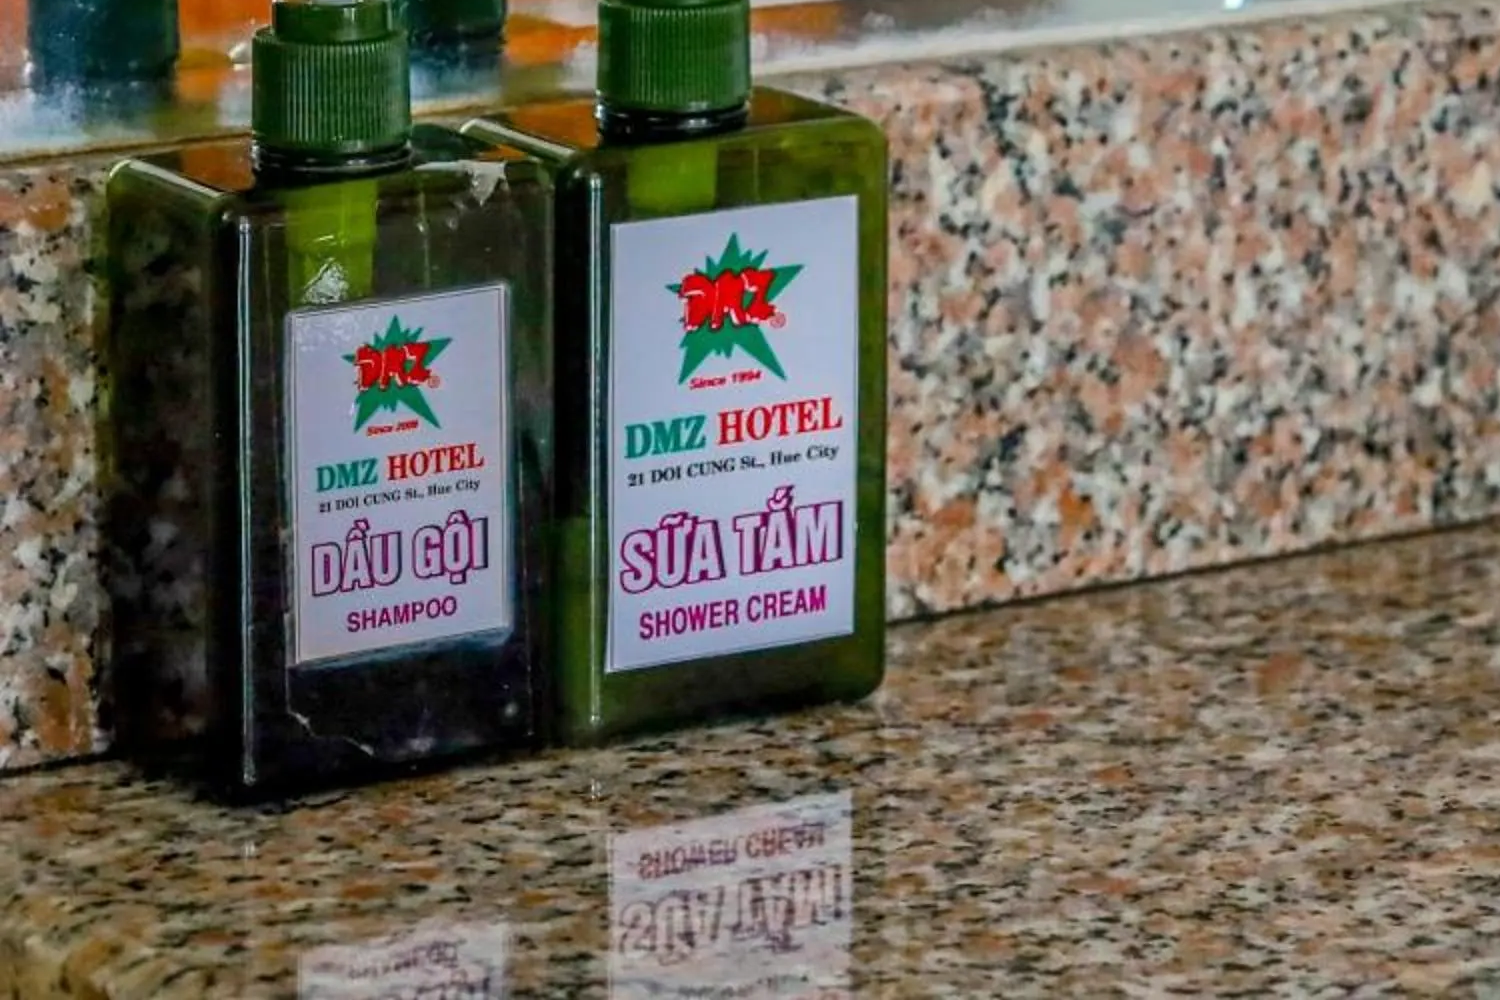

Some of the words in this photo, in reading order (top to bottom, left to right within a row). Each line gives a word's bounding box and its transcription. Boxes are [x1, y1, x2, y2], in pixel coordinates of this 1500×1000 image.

[624, 414, 708, 459] DMZ
[717, 397, 843, 446] HOTEL
[315, 457, 379, 493] DMZ
[387, 443, 484, 481] HOTEL
[627, 472, 646, 487] 21
[650, 464, 682, 484] DOI
[686, 456, 736, 479] CUNG
[770, 448, 802, 466] Hue
[805, 444, 840, 462] City
[318, 501, 332, 514] 21
[363, 489, 401, 507] CUNG
[428, 482, 453, 497] Hue
[455, 478, 481, 493] City
[312, 517, 402, 597] DẦU
[412, 509, 489, 585] GỘI
[620, 511, 728, 595] SỮA
[733, 485, 843, 576] TẮM
[347, 596, 457, 633] SHAMPOO
[639, 599, 739, 641] SHOWER
[747, 584, 827, 622] CREAM
